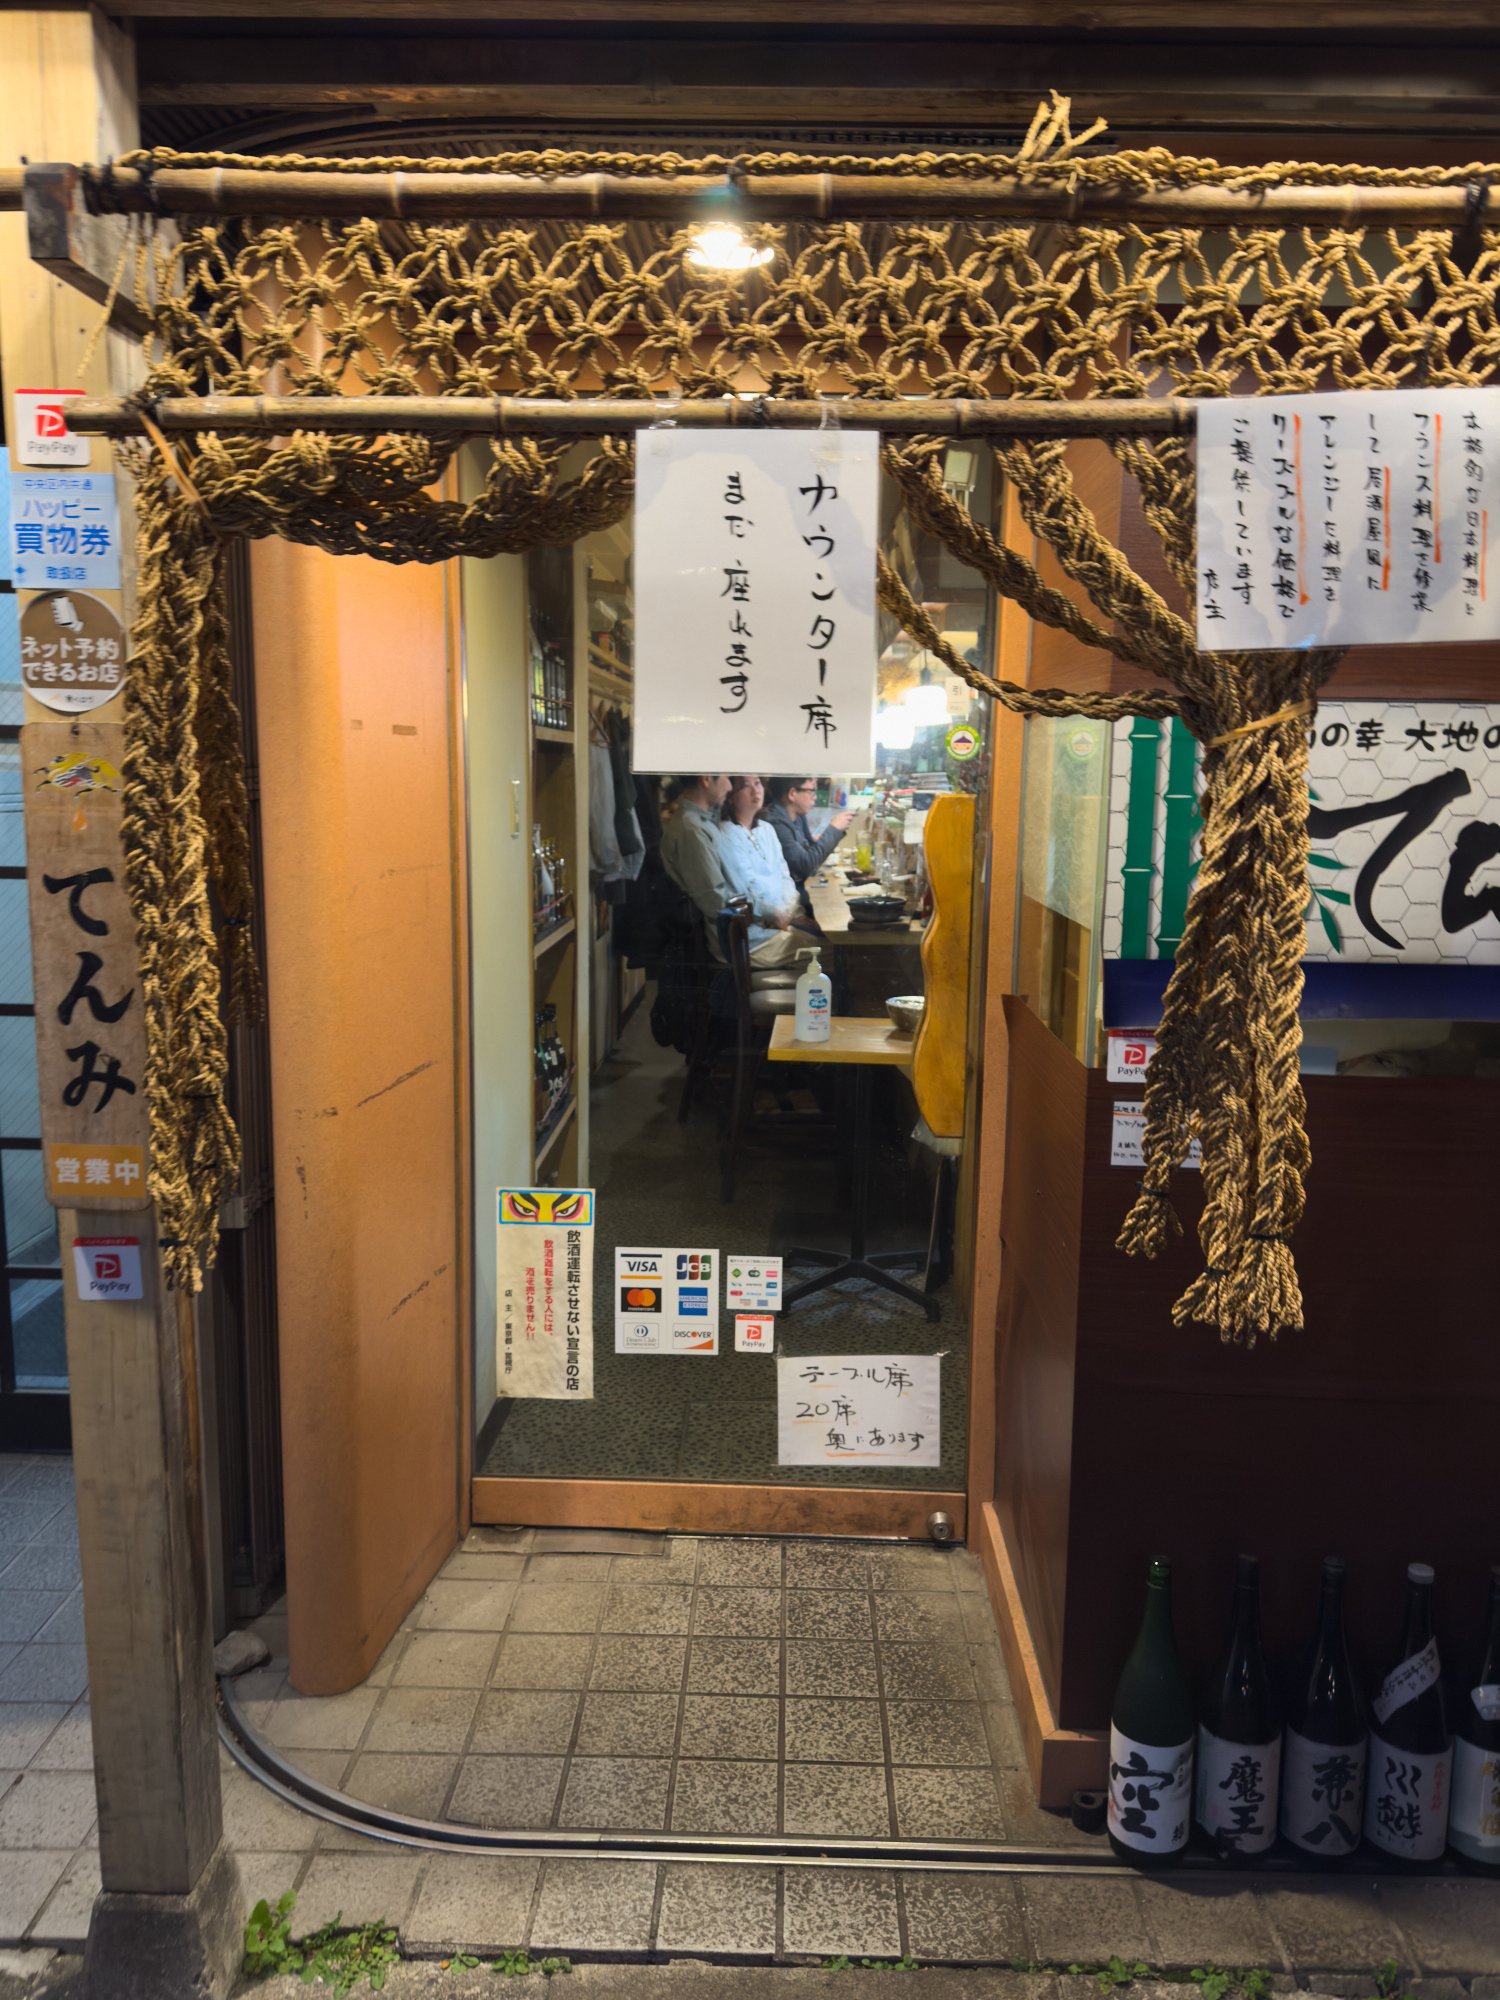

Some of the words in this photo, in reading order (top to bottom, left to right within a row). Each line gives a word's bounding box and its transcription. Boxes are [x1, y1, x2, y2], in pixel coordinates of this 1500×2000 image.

[27, 440, 77, 456] PayPay
[23, 498, 102, 519] ハッピー
[1318, 415, 1342, 602] アレンジした料理を
[1363, 413, 1383, 591] して居酒屋風に
[14, 522, 112, 556] 買物券
[45, 566, 87, 581] 取扱店
[719, 471, 755, 714] まだ座れます
[799, 473, 839, 750] カウンター席
[21, 636, 120, 660] ネット予約
[21, 661, 121, 684] できるお店
[1308, 718, 1385, 752] の幸
[43, 867, 137, 1114] てんみ
[1117, 1066, 1146, 1077] PayPa
[55, 1157, 141, 1187] 営業中
[626, 1261, 658, 1273] VISA
[90, 1281, 131, 1293] PayPay
[566, 1229, 582, 1391] 飲酒運転させない宣言の店
[674, 1330, 712, 1338] DISCOVER
[742, 1340, 766, 1348] PayPay
[799, 1362, 914, 1398] テーブル席
[796, 1394, 857, 1426] 20席
[825, 1427, 925, 1452] 奥にあります
[1111, 1751, 1175, 1839] 空
[1219, 1755, 1265, 1837] 魔王
[1302, 1754, 1359, 1847] 兼八
